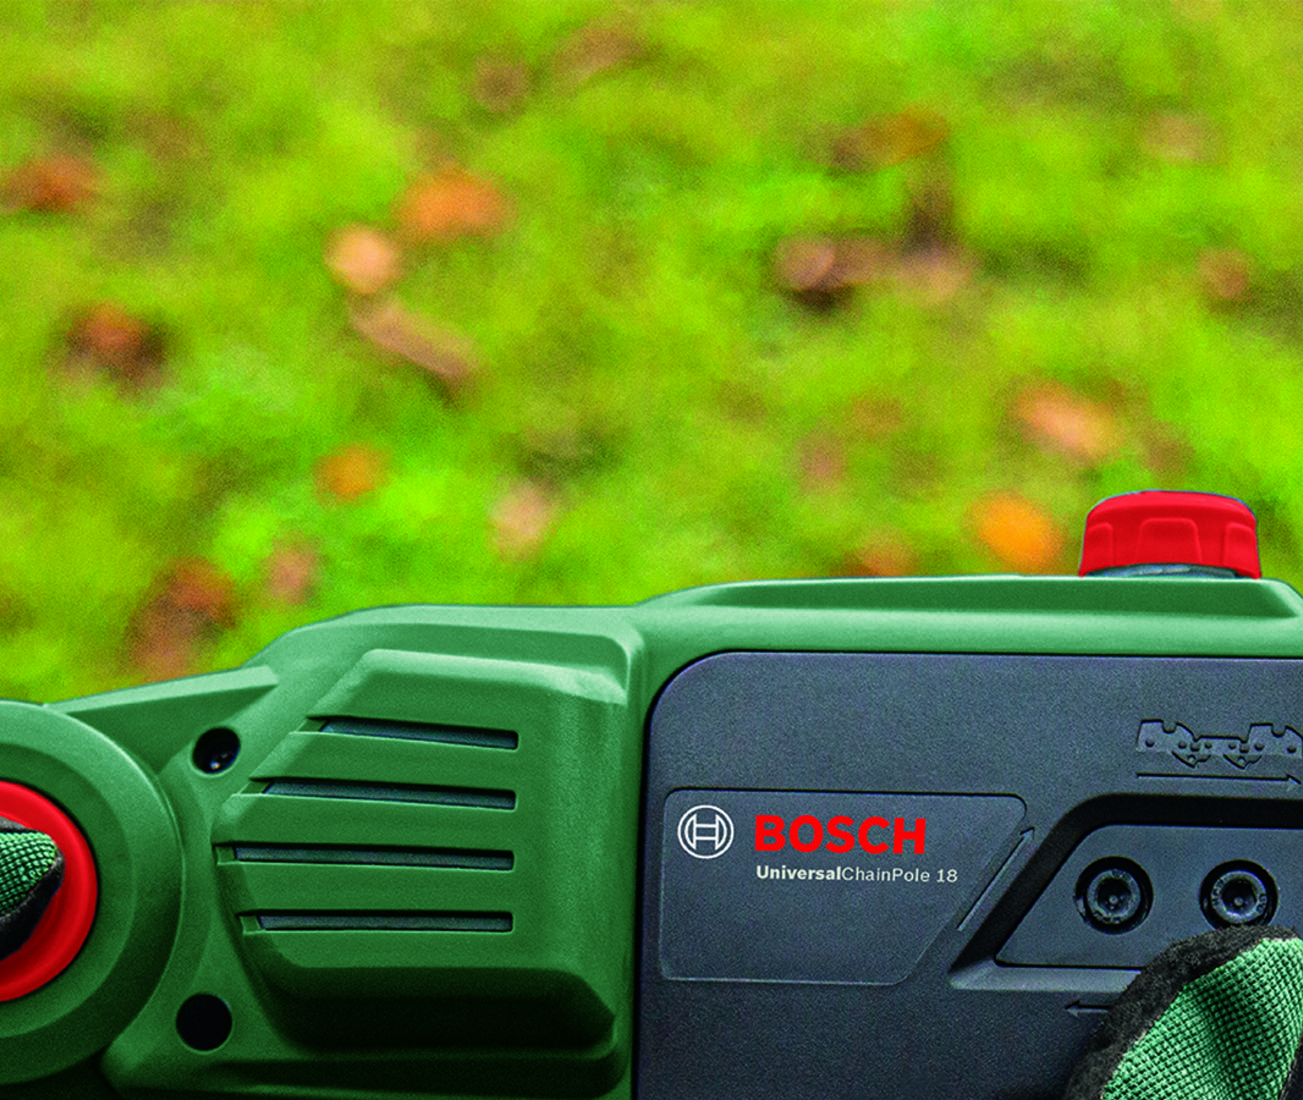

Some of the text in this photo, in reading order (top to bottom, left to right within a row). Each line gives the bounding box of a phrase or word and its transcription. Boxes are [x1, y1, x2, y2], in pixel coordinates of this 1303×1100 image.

[754, 814, 927, 855] BOSCH
[756, 864, 958, 884] UniversalChainPole 18
